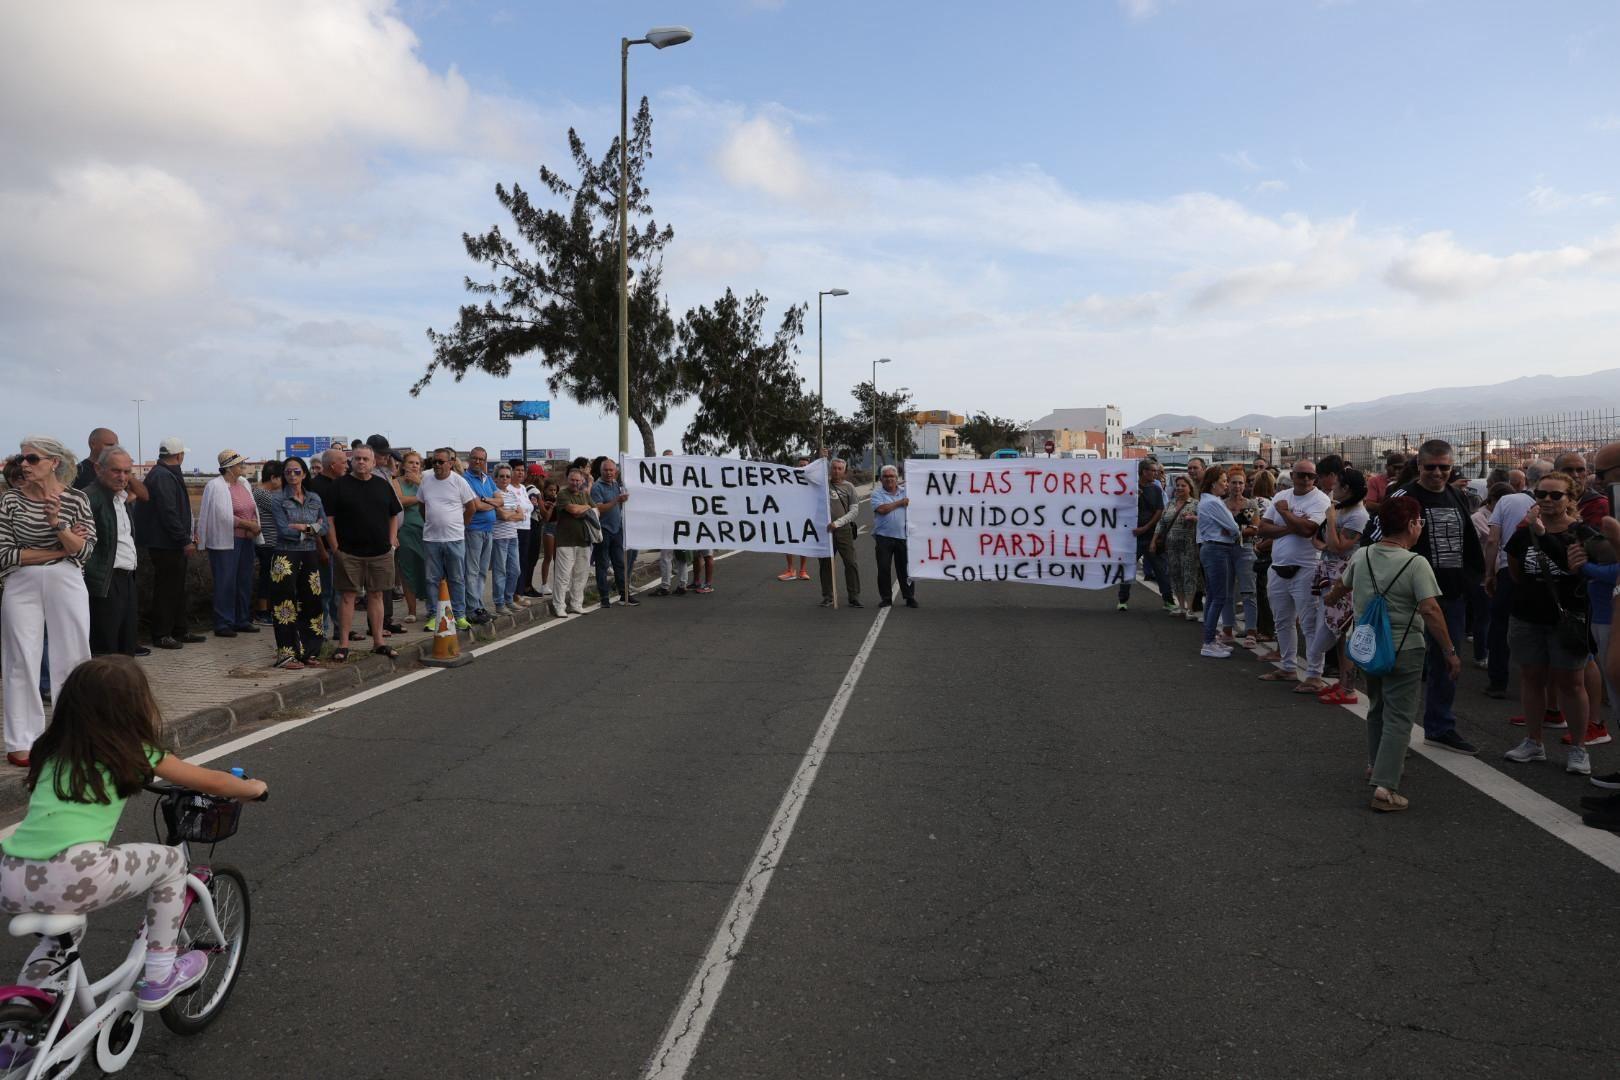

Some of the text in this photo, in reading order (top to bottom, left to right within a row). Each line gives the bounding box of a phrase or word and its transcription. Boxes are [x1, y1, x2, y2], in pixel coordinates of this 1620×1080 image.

[639, 460, 810, 488] NO AL CIERRE
[925, 472, 961, 496] AV.
[970, 471, 1012, 494] LAS
[692, 494, 779, 515] DE LA
[673, 518, 820, 545] PARDILLA
[1102, 563, 1126, 585] YA
